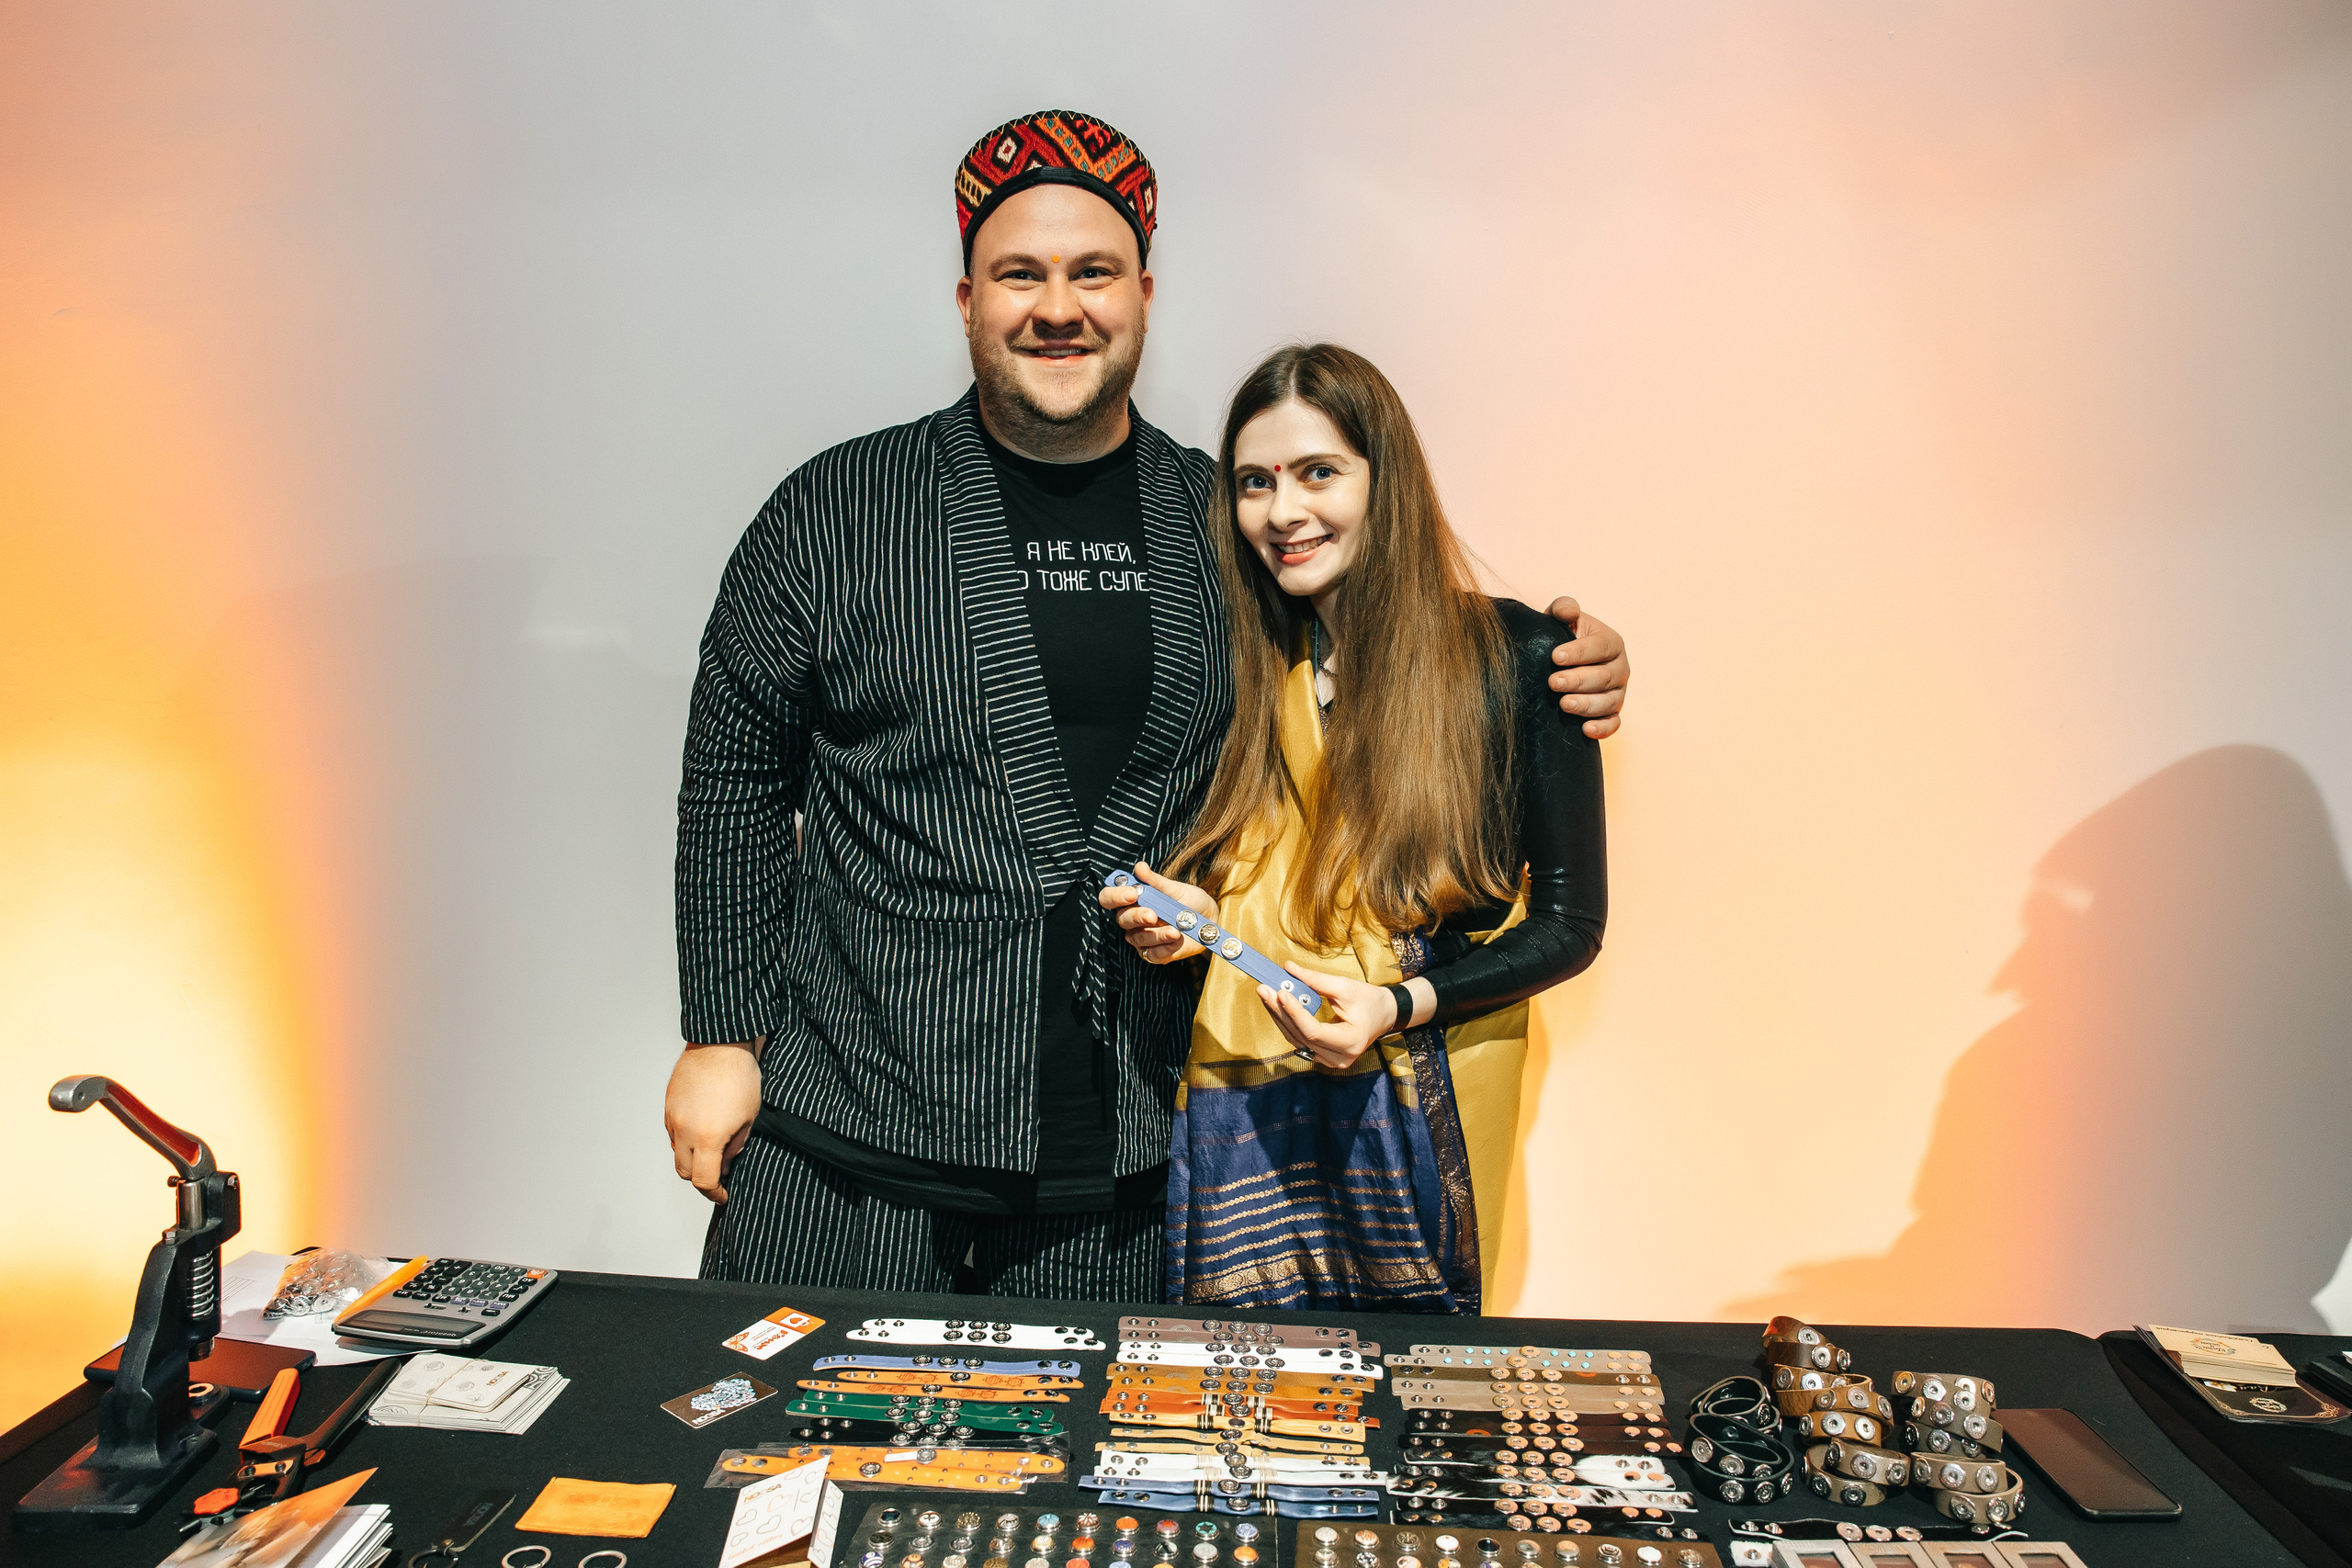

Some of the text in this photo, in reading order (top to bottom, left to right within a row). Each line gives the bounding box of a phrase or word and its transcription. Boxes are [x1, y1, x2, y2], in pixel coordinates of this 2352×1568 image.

[1026, 540, 1136, 565] Я НЕ КЛЕЙ,
[1036, 570, 1092, 592] ТОЖЕ
